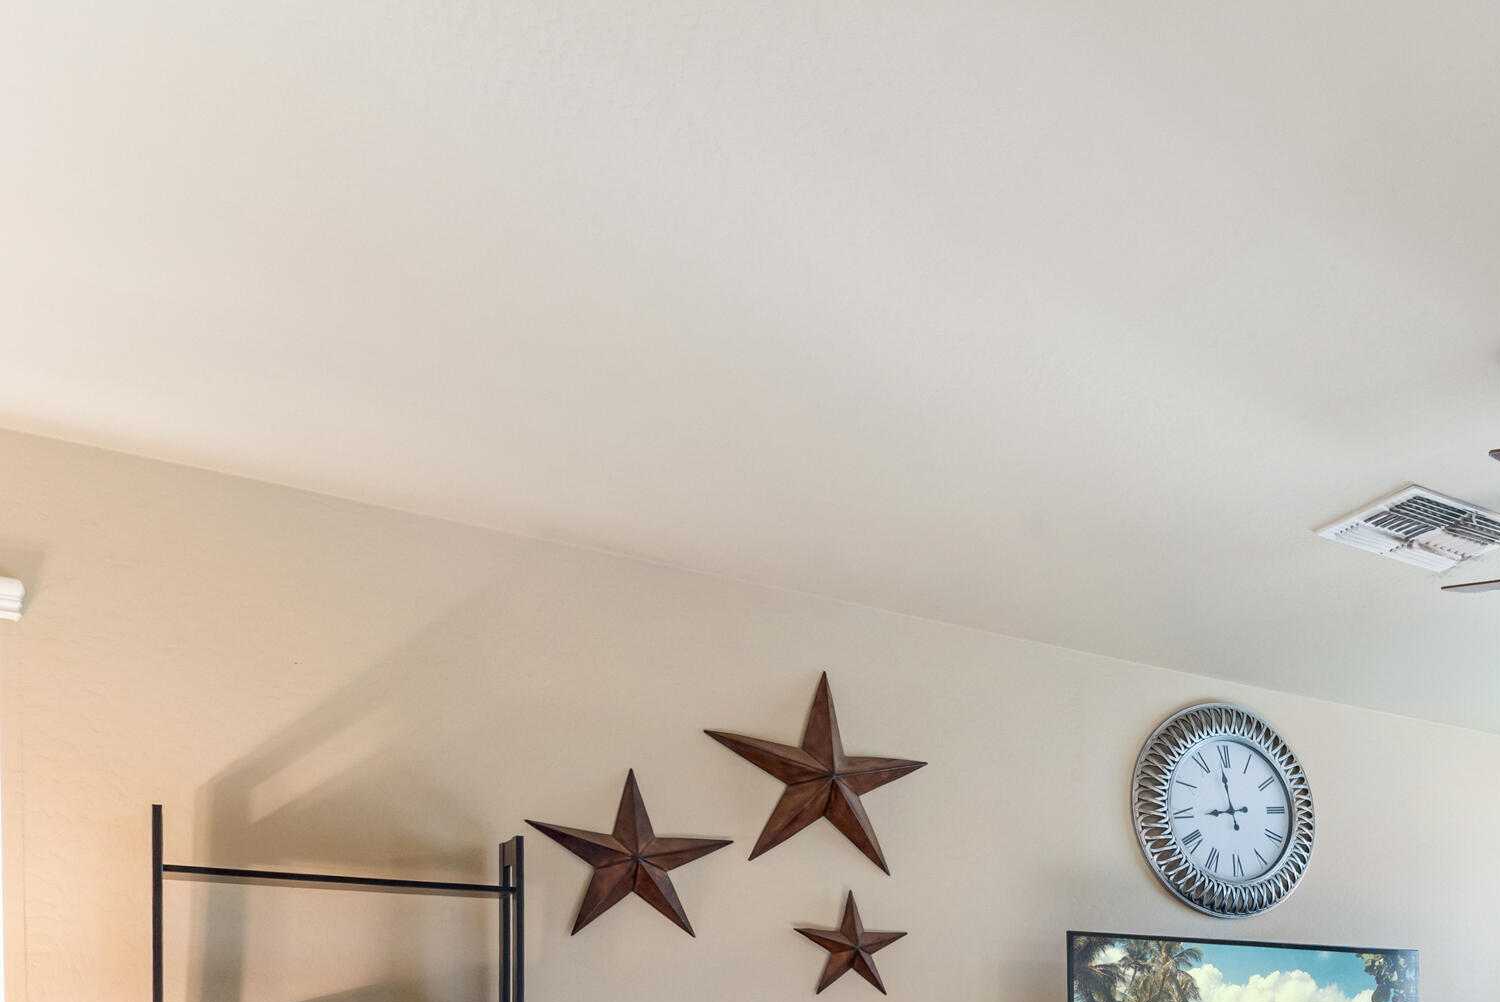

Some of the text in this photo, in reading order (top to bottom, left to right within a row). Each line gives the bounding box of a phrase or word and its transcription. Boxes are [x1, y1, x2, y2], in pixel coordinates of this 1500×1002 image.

[1243, 754, 1252, 774] I
[1257, 776, 1275, 791] II
[1265, 806, 1285, 815] III
